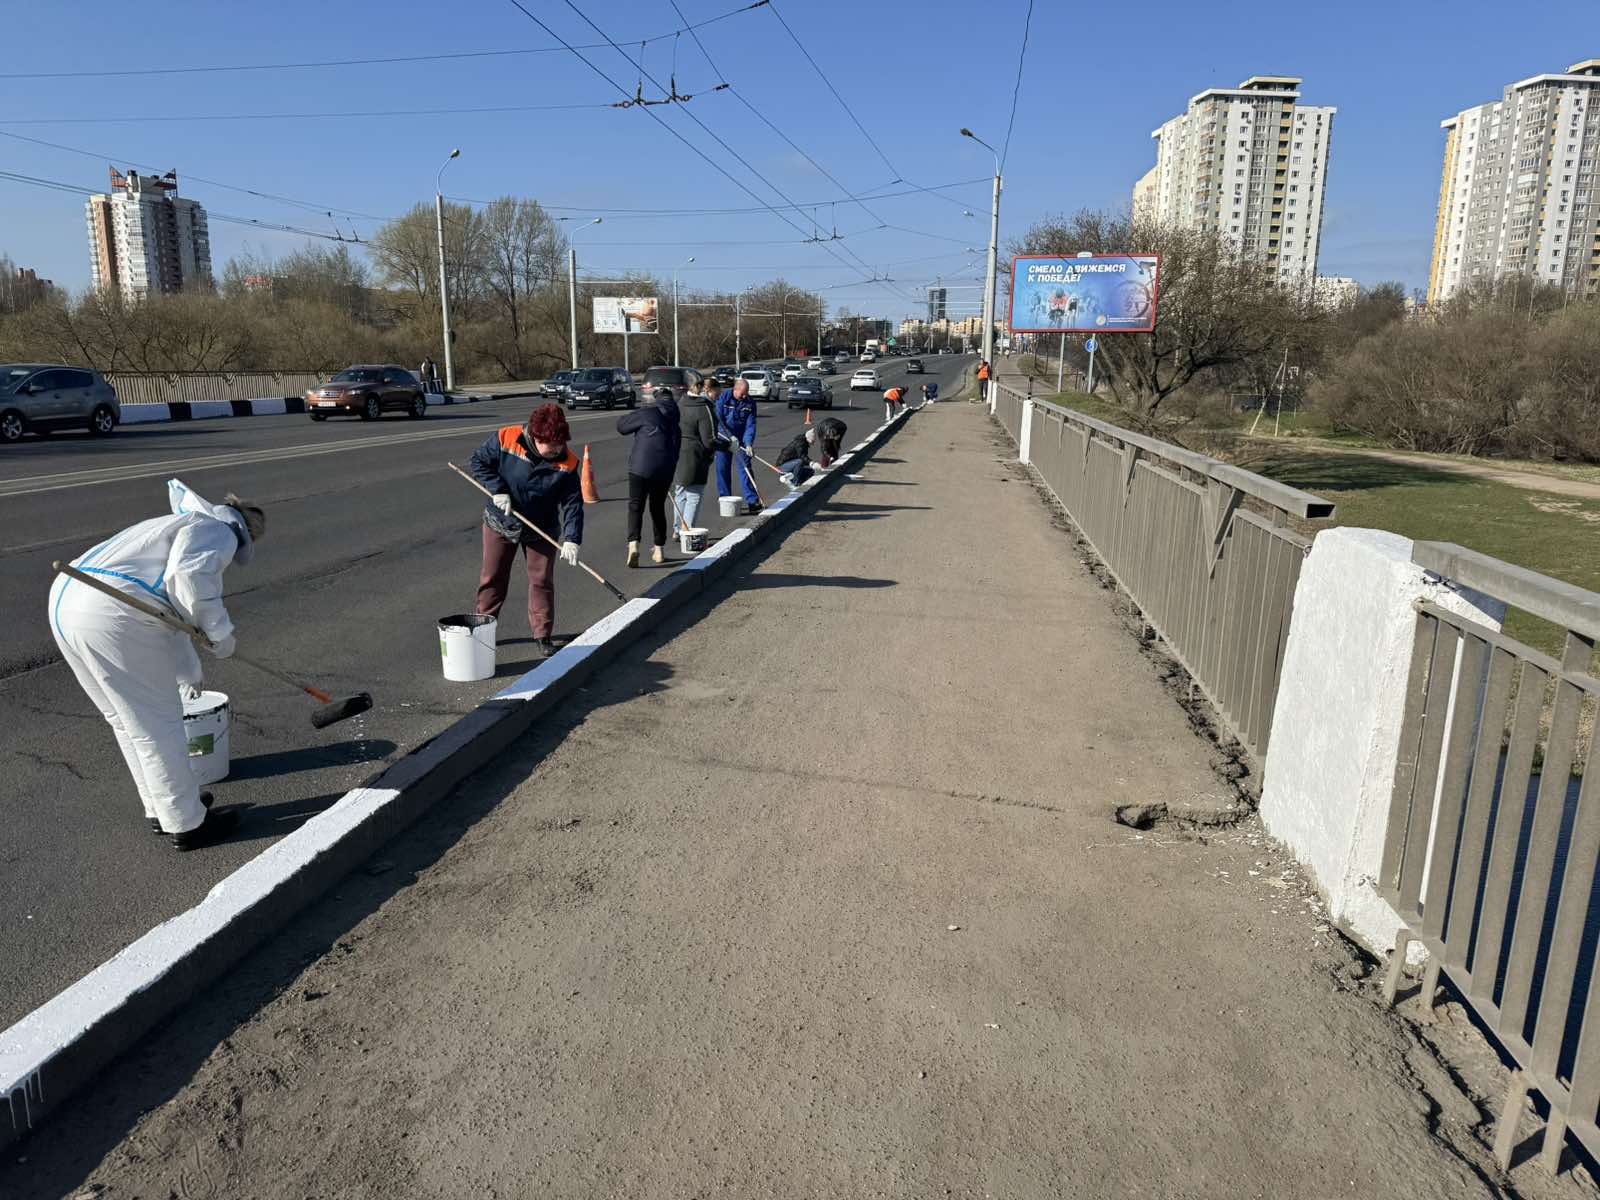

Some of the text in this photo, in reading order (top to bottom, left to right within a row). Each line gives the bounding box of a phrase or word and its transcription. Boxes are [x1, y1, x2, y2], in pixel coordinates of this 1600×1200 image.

[1028, 265, 1062, 273] СМЕЛО
[1028, 274, 1081, 283] К ПОБЕДЕ!
